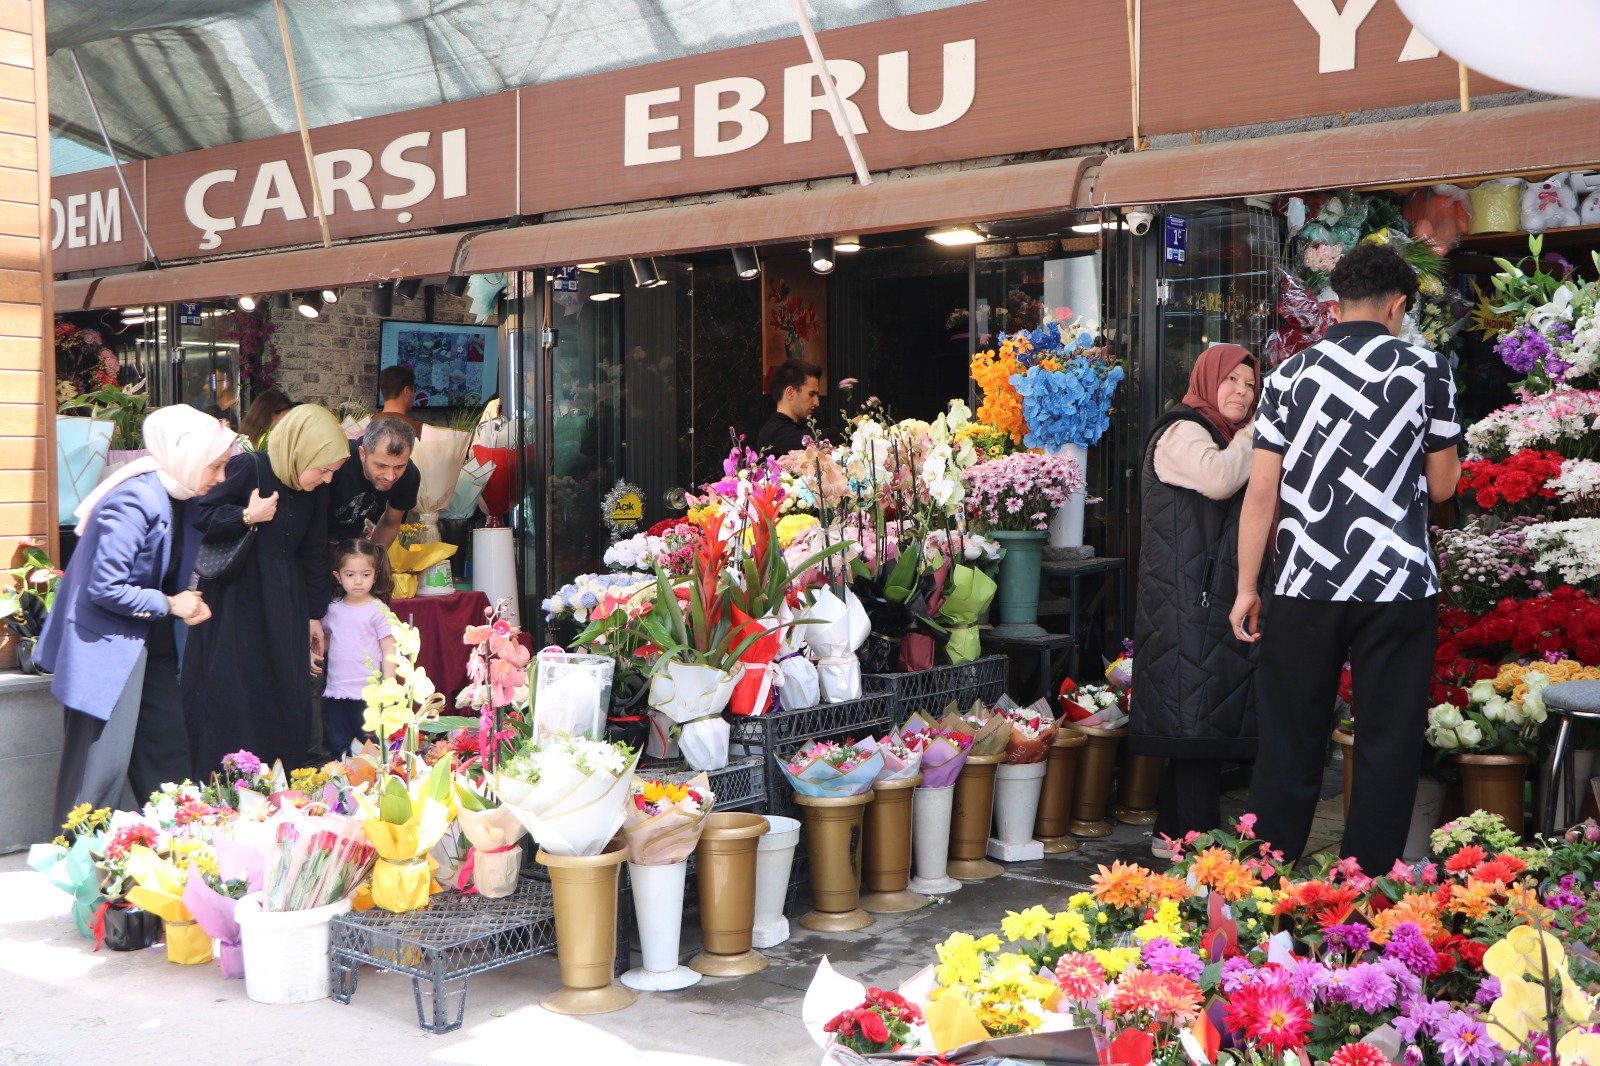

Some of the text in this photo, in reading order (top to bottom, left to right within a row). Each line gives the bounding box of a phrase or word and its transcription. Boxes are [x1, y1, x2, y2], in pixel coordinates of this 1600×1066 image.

[623, 39, 976, 167] EBRU
[185, 127, 469, 250] ÇARŞI
[614, 501, 635, 514] Açık
